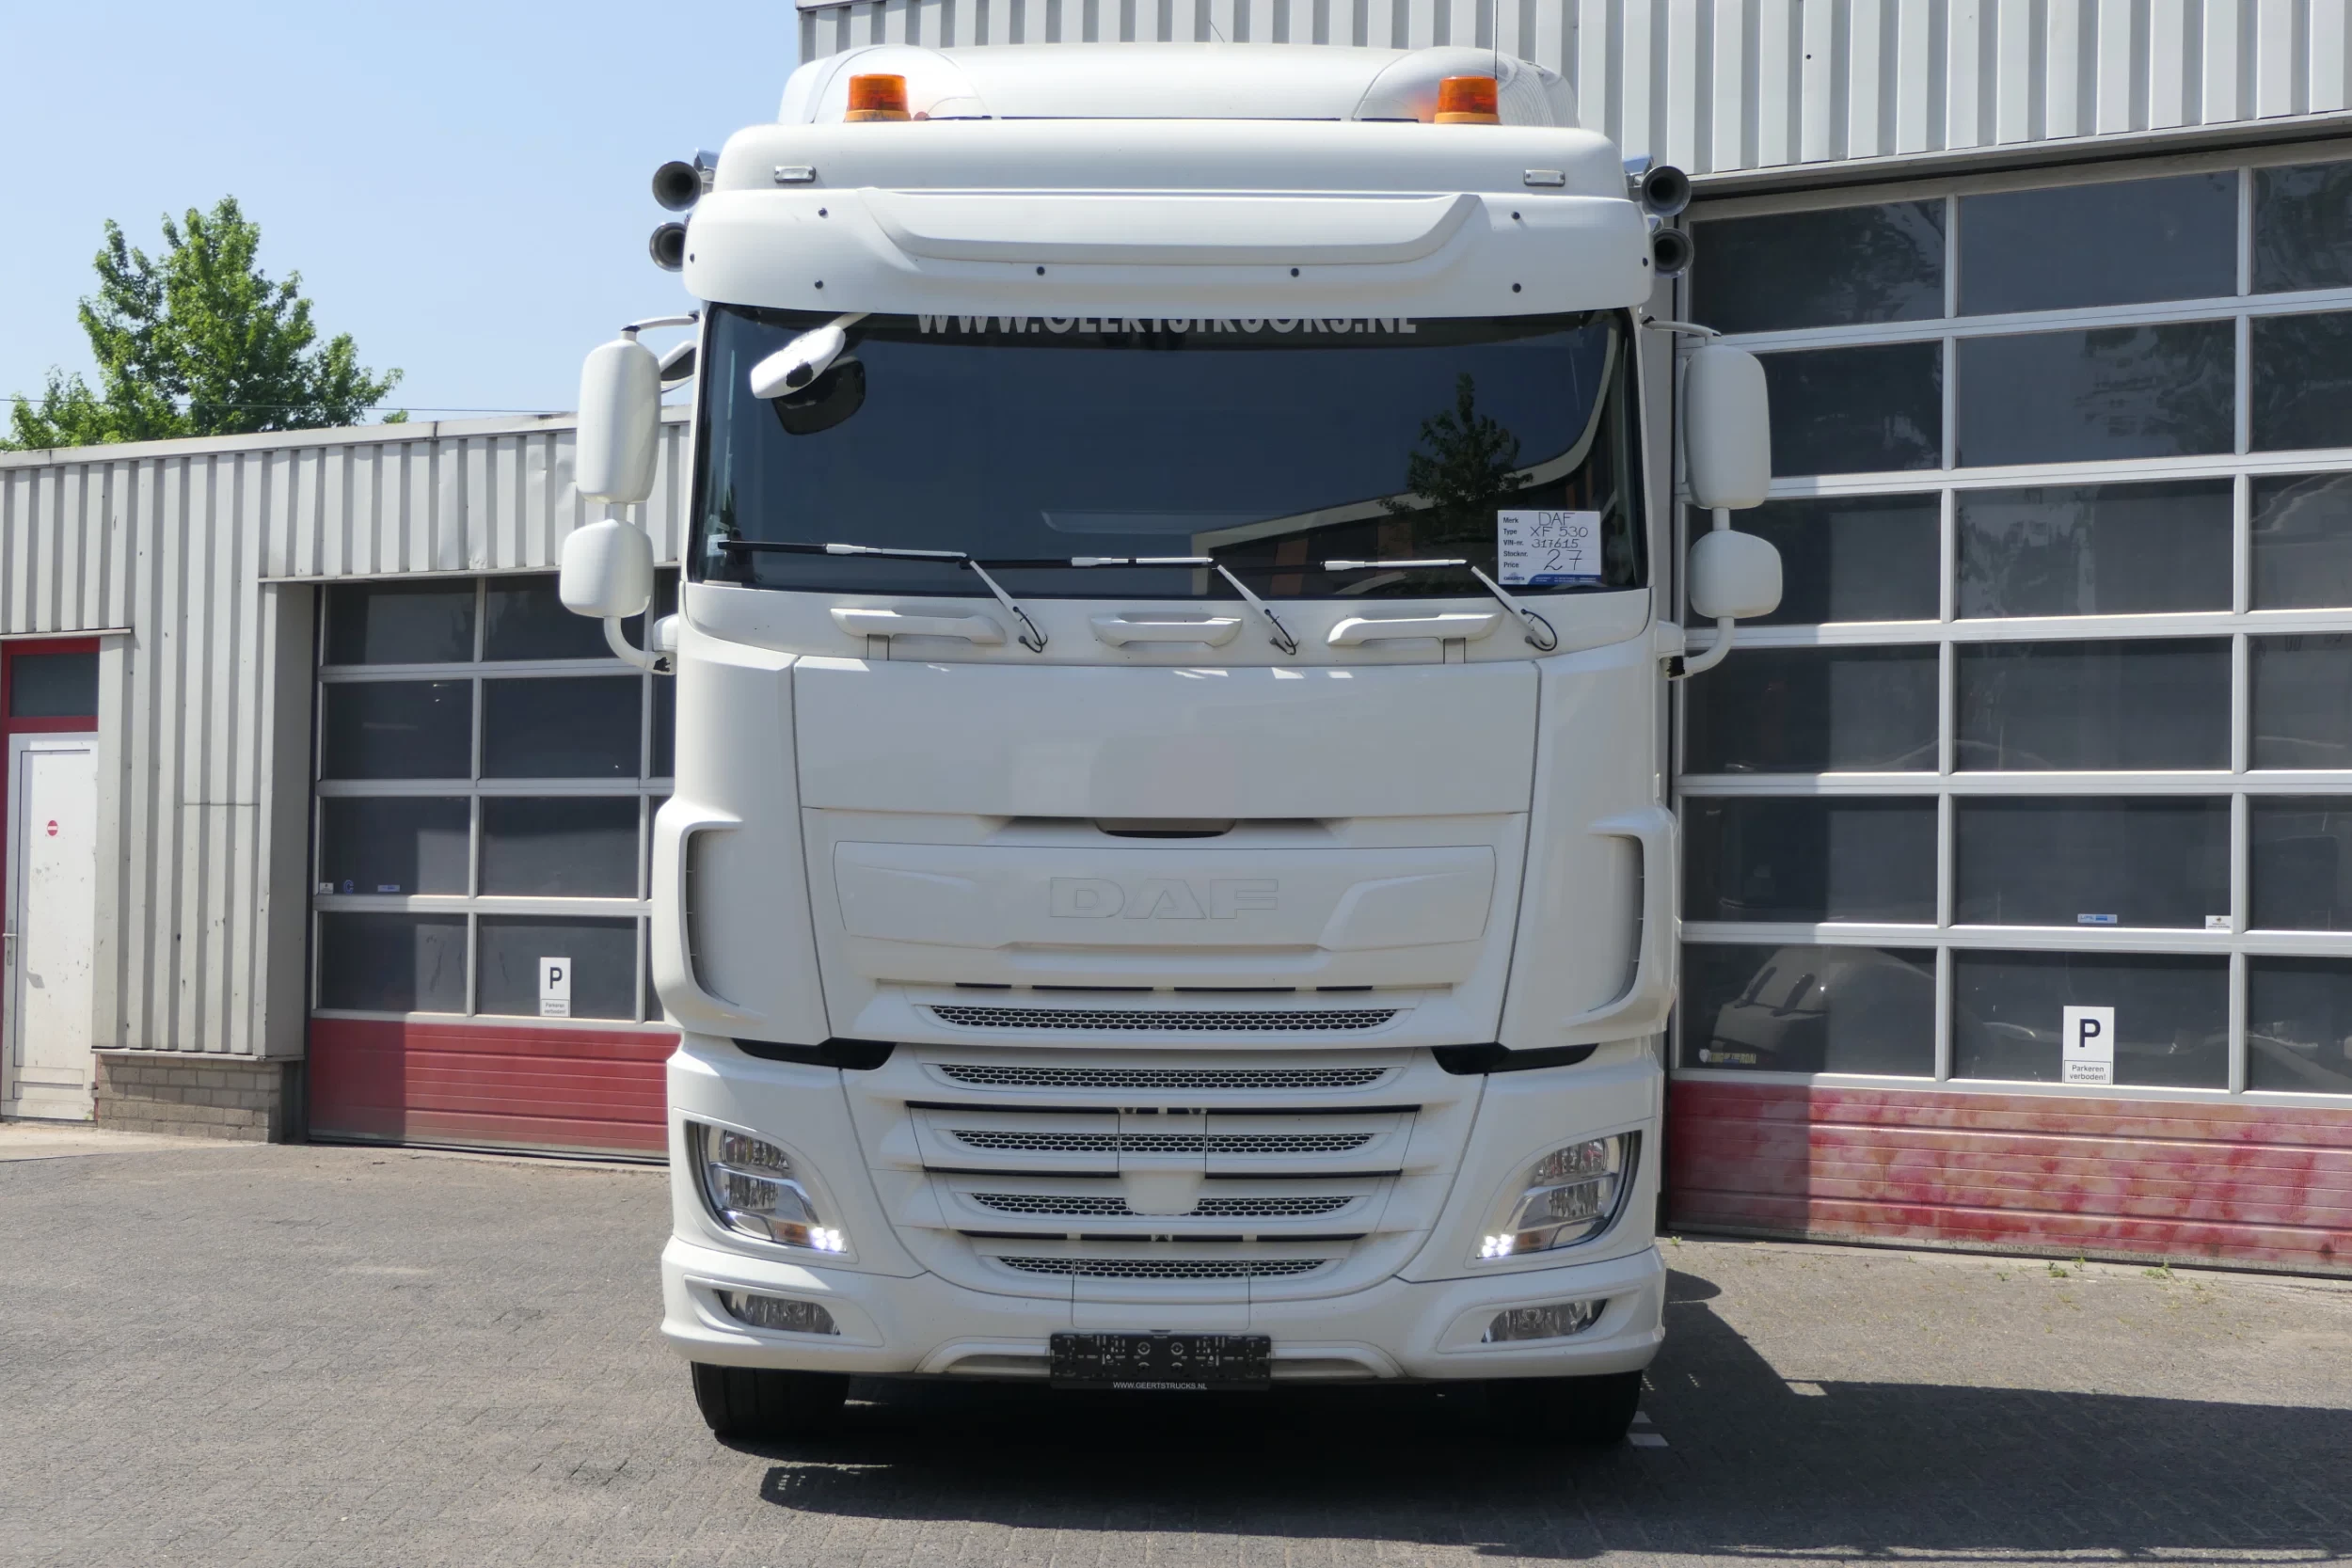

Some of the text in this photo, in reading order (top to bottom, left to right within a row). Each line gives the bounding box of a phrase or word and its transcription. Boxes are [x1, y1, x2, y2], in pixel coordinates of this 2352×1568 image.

[1538, 512, 1576, 526] DAF
[1530, 526, 1553, 537] XF
[1558, 526, 1589, 538] 530
[1531, 537, 1580, 548] 317615
[1049, 877, 1279, 920] DAF
[549, 967, 563, 990] P
[2079, 1019, 2102, 1048] P
[2072, 1064, 2105, 1073] Parkeren
[2069, 1072, 2106, 1081] verboden!
[1113, 1381, 1208, 1390] WWW.GEERTSTRUCKS.NL
